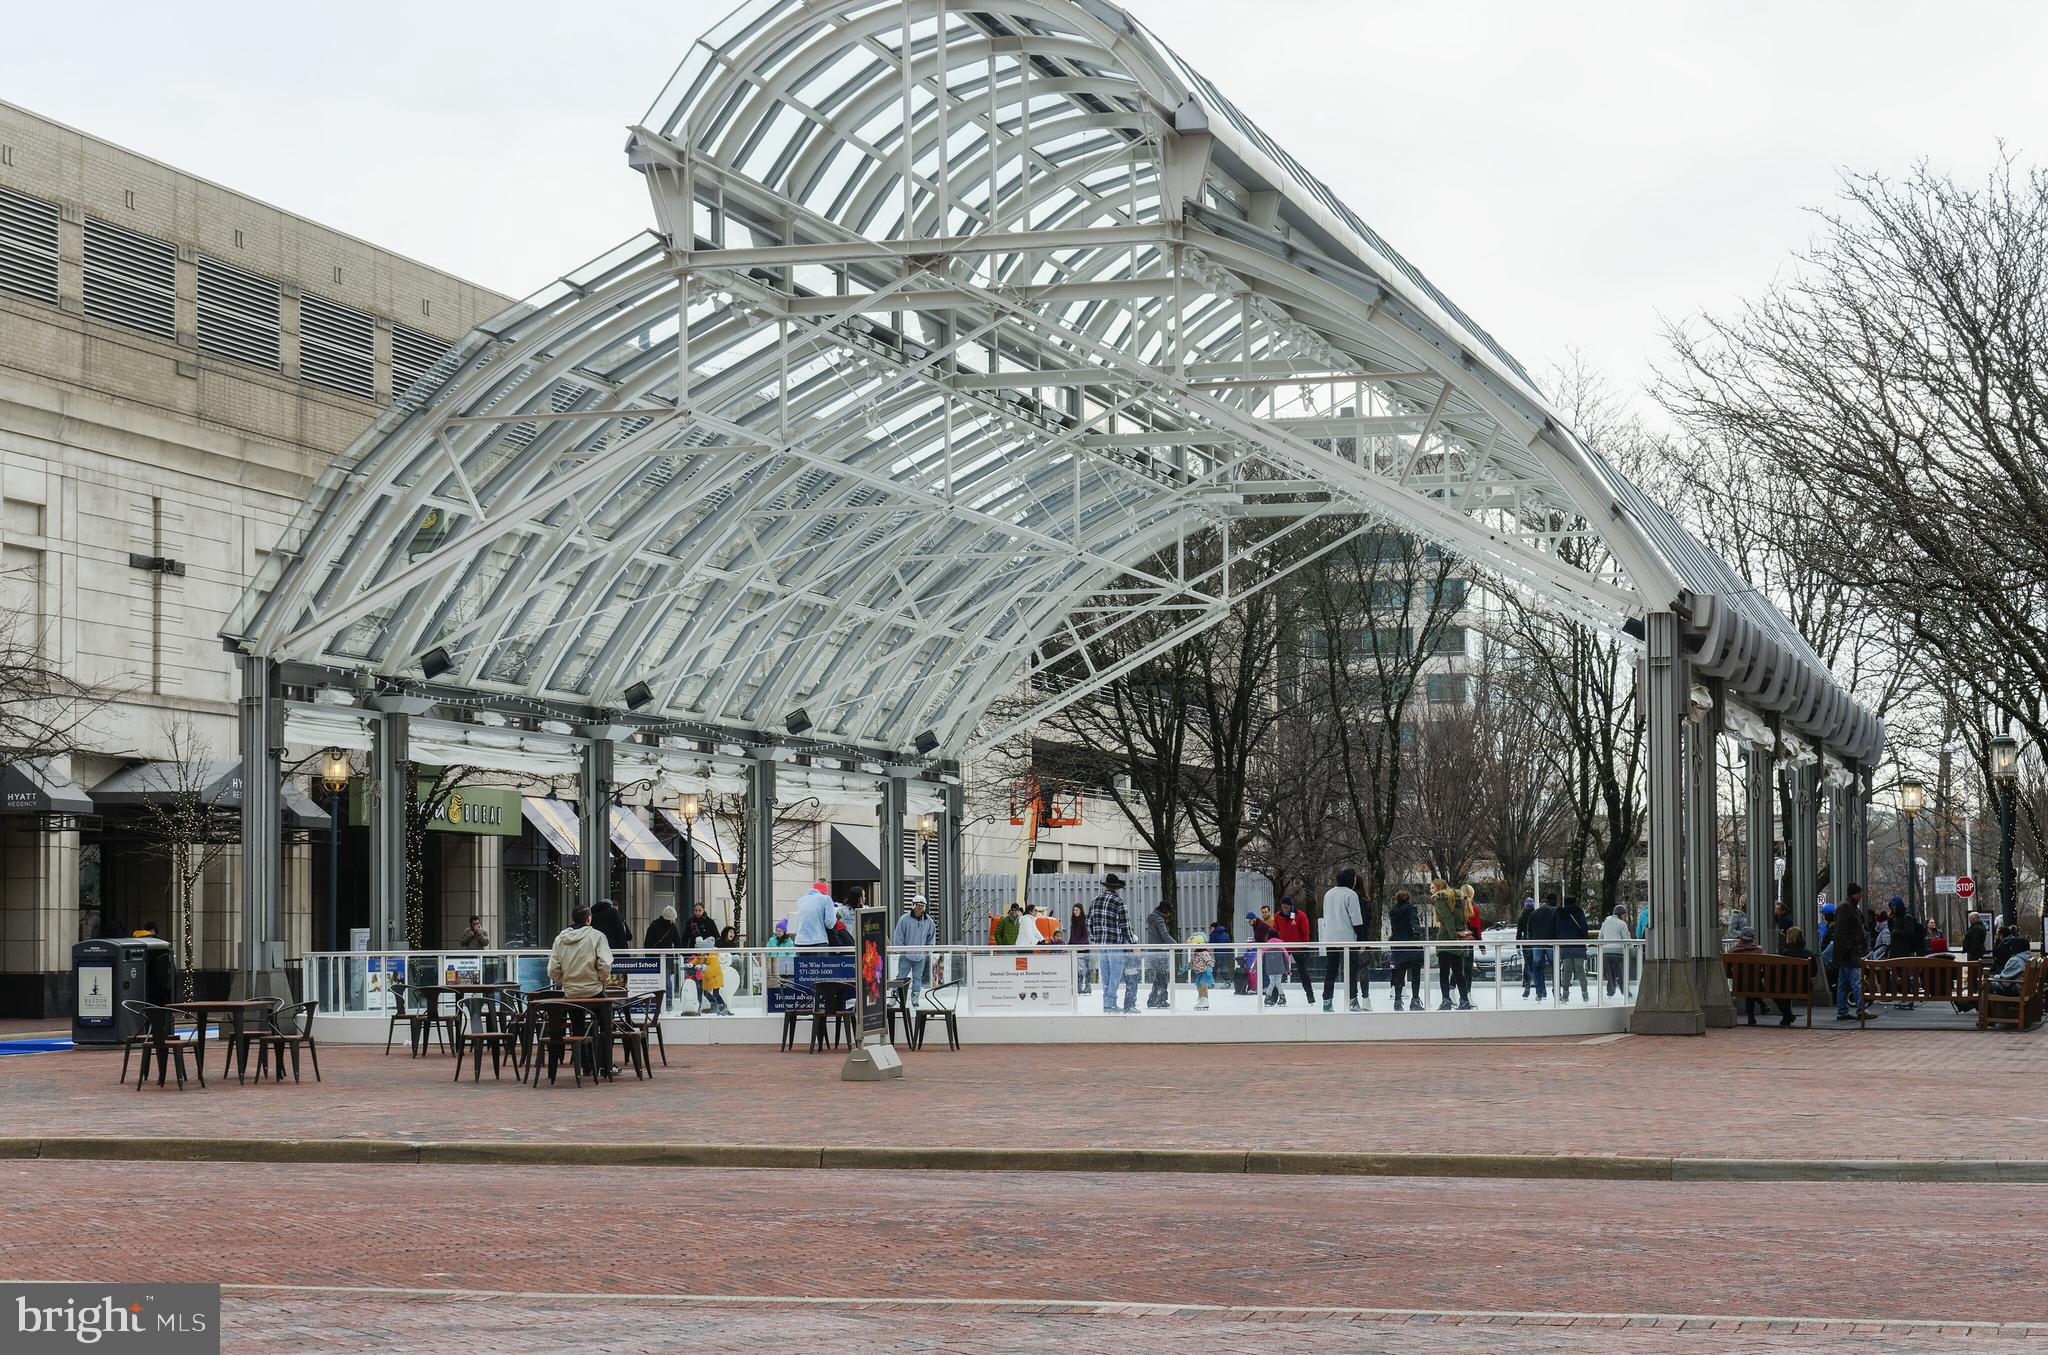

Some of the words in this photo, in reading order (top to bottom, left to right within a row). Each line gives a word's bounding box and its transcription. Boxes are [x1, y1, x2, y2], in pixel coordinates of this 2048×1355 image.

[7, 793, 37, 801] HYATT
[464, 803, 502, 825] BREAD
[1956, 883, 1974, 892] STOP
